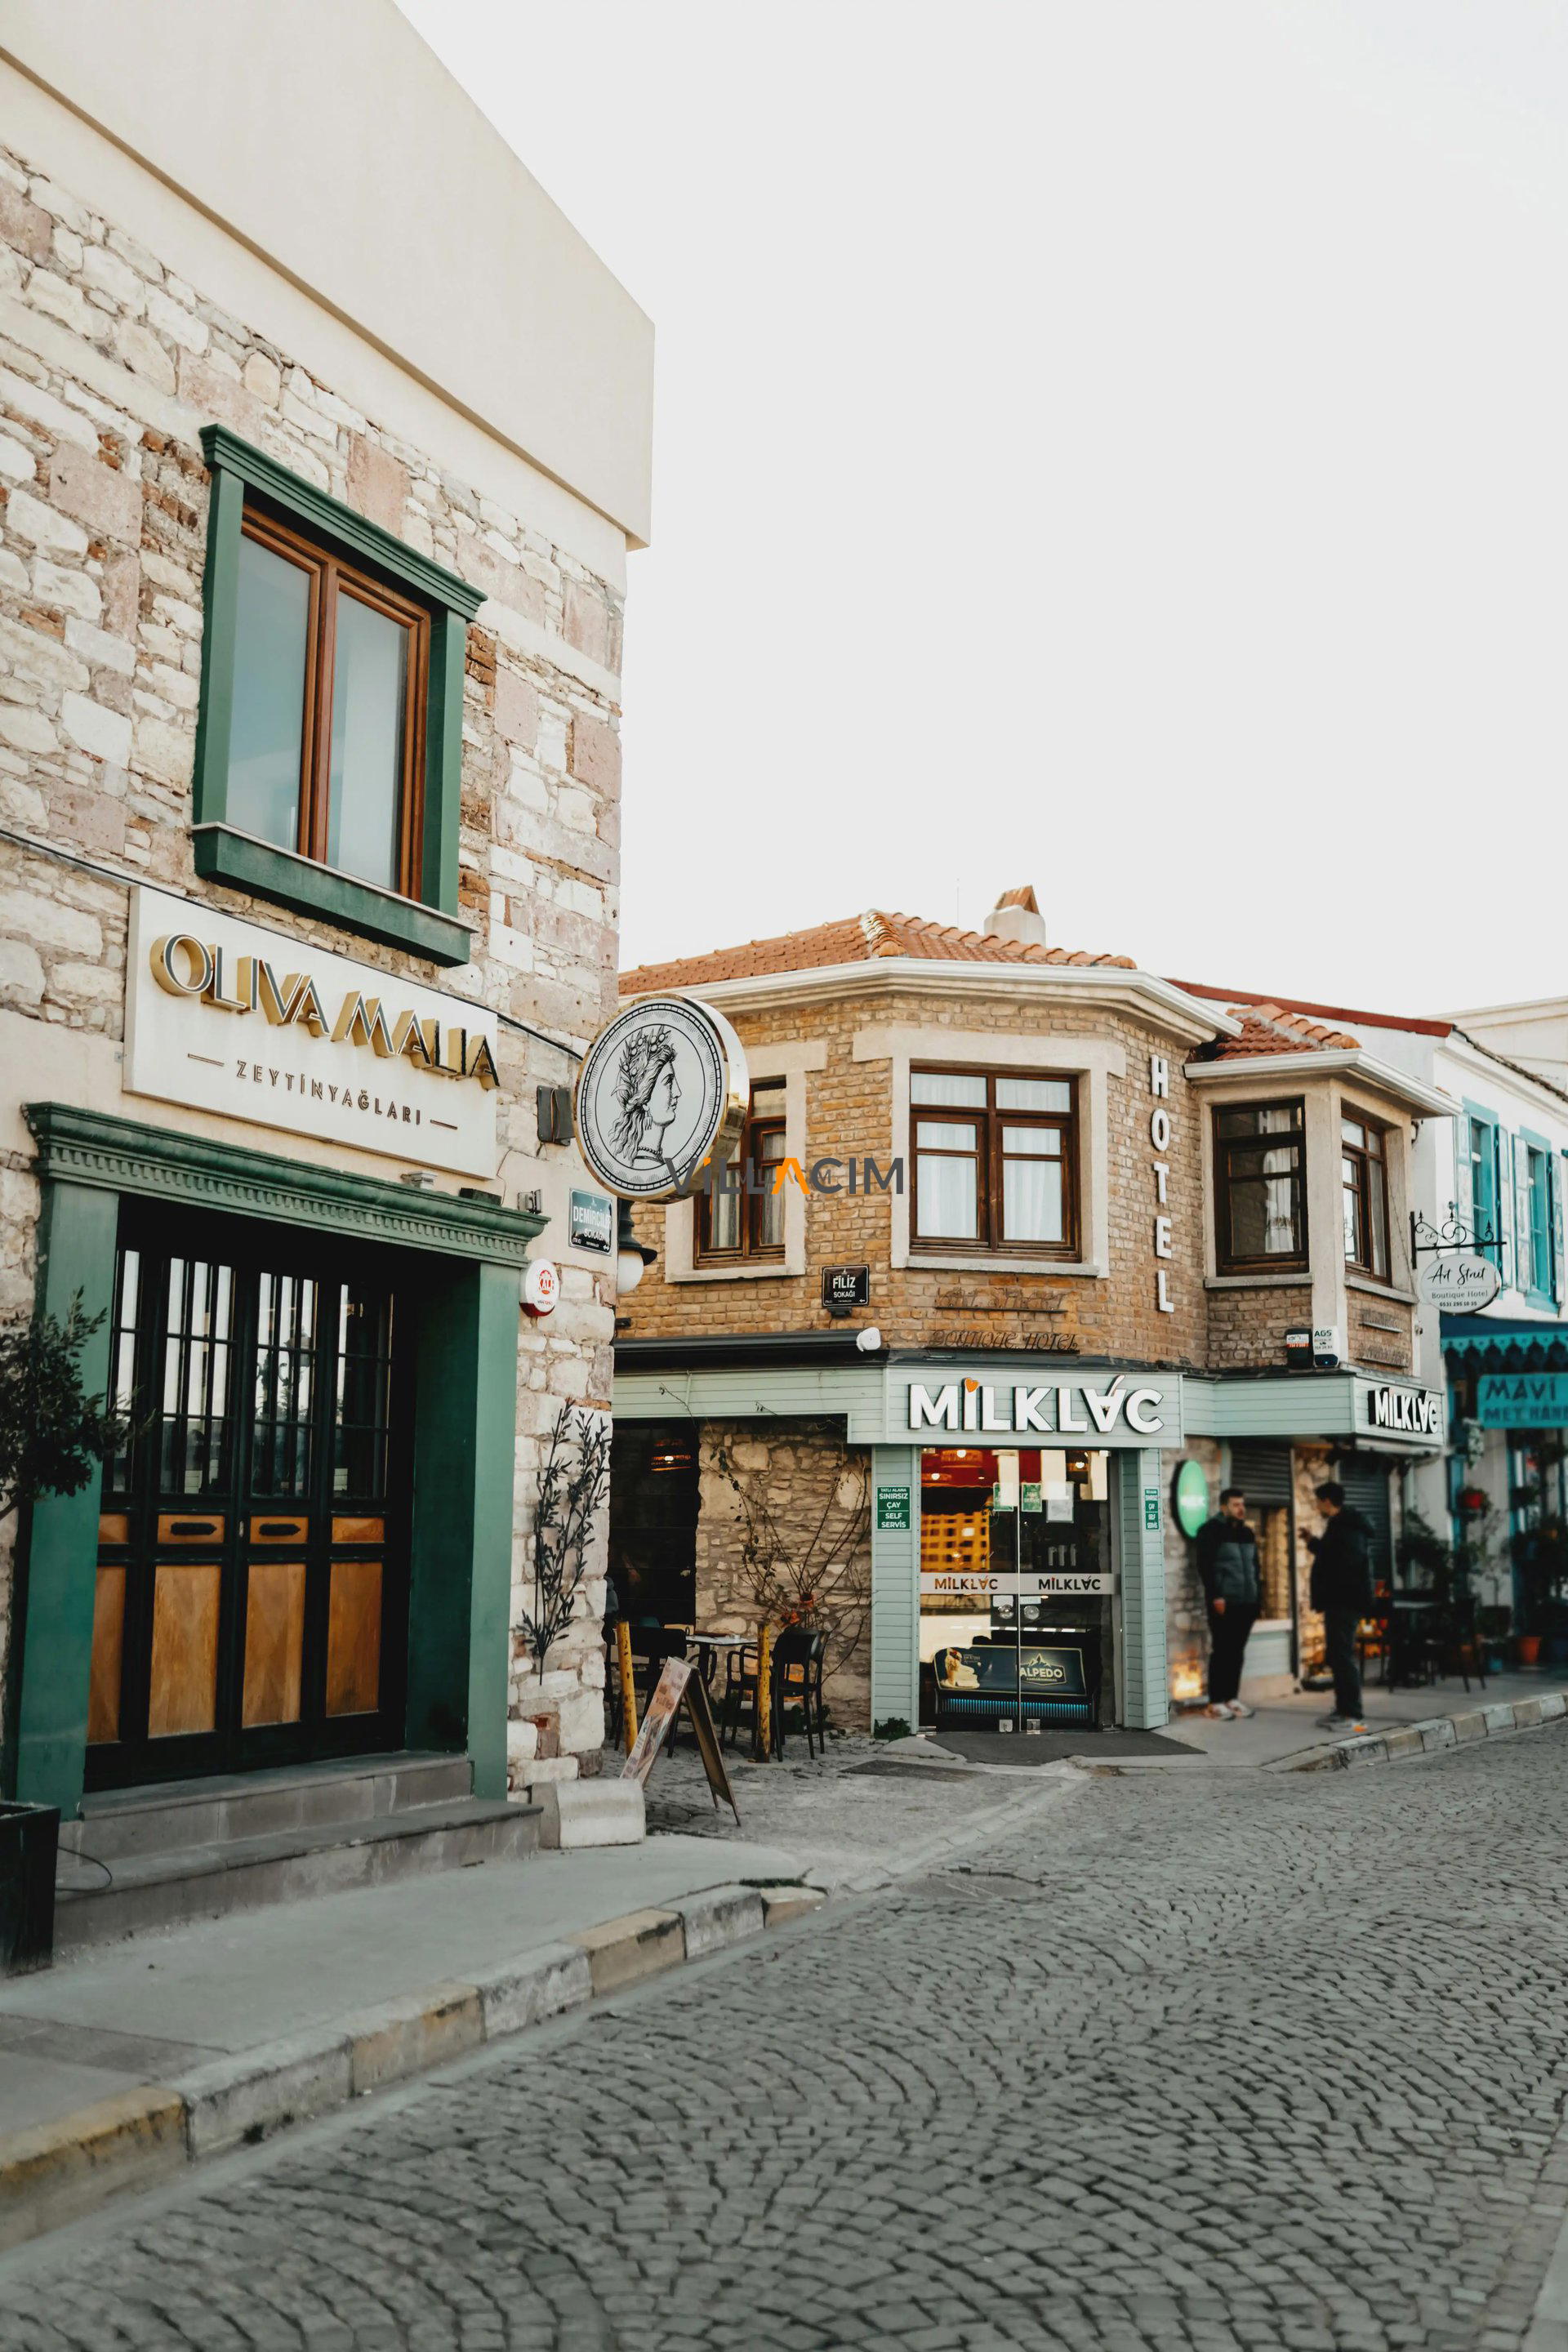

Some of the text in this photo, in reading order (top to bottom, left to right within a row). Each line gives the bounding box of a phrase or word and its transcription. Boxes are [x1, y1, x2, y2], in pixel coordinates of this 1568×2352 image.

[151, 933, 501, 1091] OLIVA MALIA
[237, 1059, 421, 1125] ZEYTİNYAĞLARI
[1151, 1054, 1174, 1313] HOTEL
[833, 1275, 856, 1289] FİLİZ
[833, 1290, 856, 1298] SOKAĞI
[1018, 1667, 1062, 1678] ALPEDO
